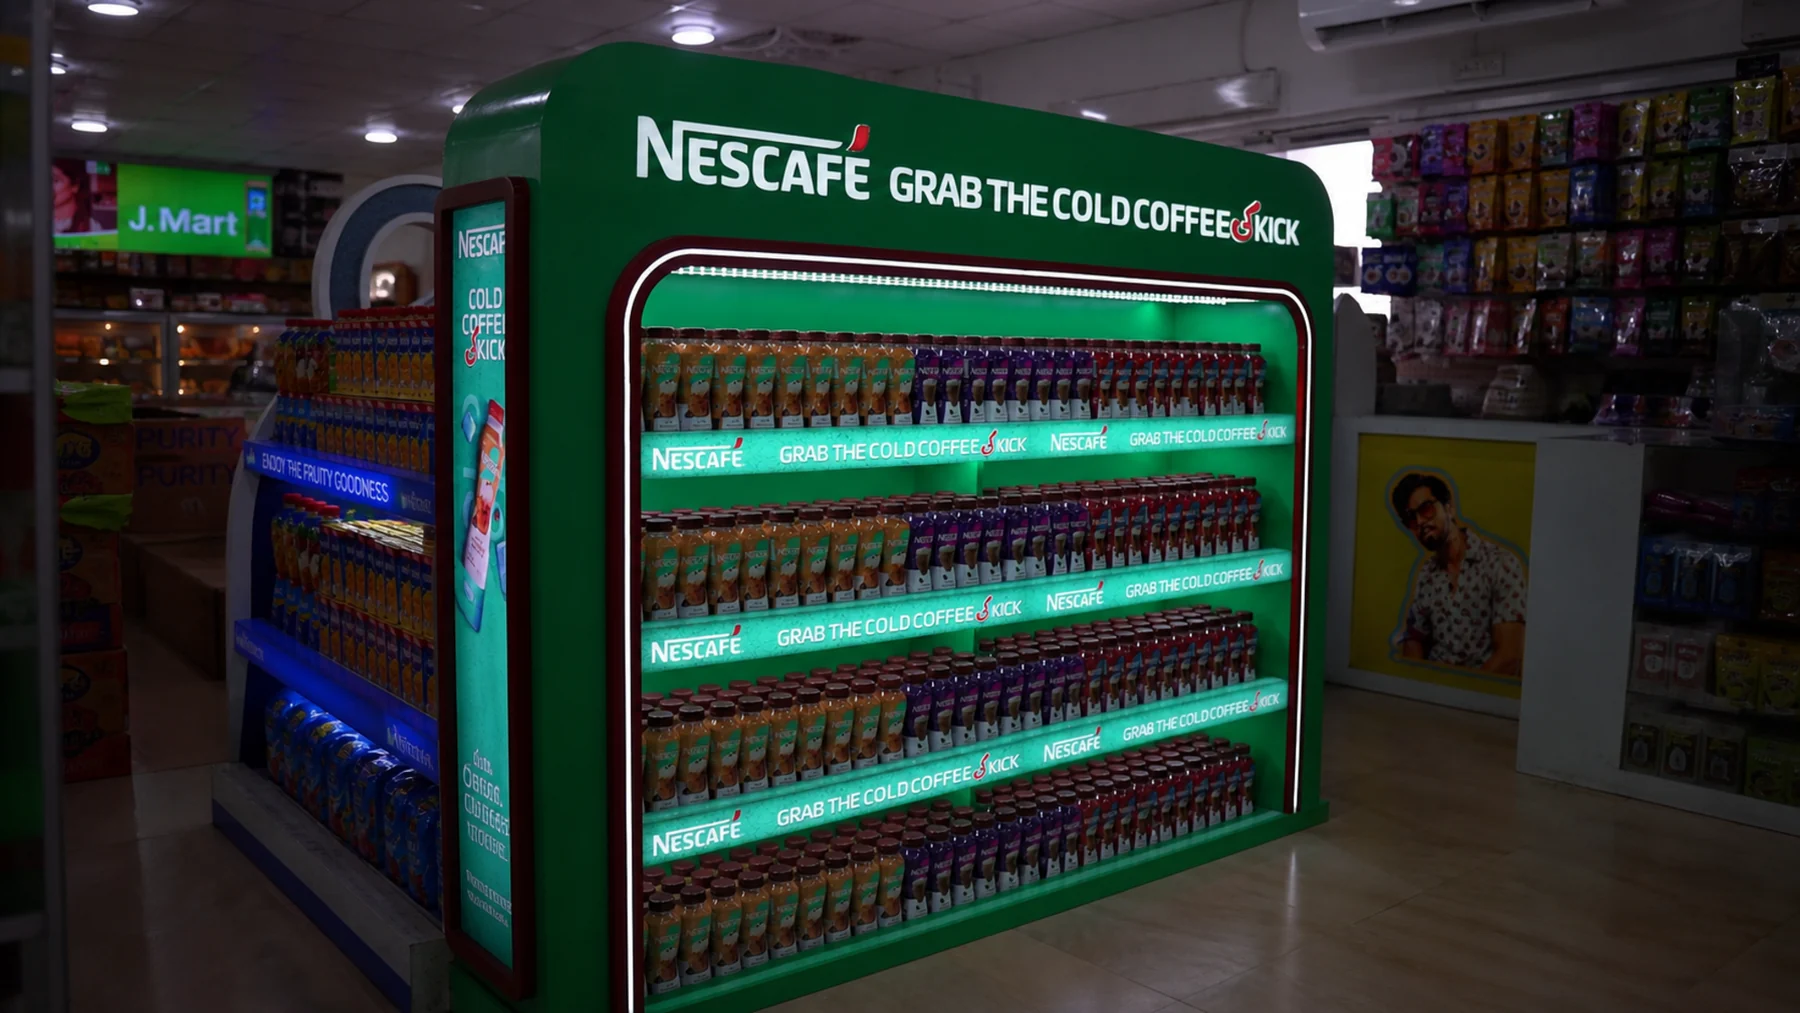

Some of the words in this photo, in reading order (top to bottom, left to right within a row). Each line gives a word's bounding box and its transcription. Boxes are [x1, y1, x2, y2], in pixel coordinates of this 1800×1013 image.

[636, 115, 870, 200] NESCAFÉ
[128, 205, 154, 232] J.
[158, 207, 239, 236] Mart
[889, 166, 983, 209] GRAB
[986, 178, 1049, 218] THE
[1052, 187, 1131, 227] COLD
[1132, 198, 1231, 239] COFFEE
[1254, 214, 1300, 246] KICK
[468, 287, 503, 310] COLD
[477, 338, 506, 361] KICK
[137, 426, 240, 449] PURITY
[779, 444, 828, 464] GRAB
[832, 442, 867, 461] THE
[869, 440, 915, 459] COLD
[918, 438, 980, 457] COFFEE
[997, 437, 1027, 453] KICK
[1129, 430, 1161, 446] GRAB
[1164, 429, 1184, 444] THE
[1186, 428, 1216, 443] COLD
[1217, 427, 1256, 442] COFFEE
[262, 453, 287, 474] ENJOY
[287, 459, 302, 479] THE
[303, 463, 333, 488] FRUITY
[334, 471, 389, 503] GOODNESS
[1126, 583, 1157, 598] GRAB
[1159, 578, 1180, 594] THE
[1182, 574, 1211, 590] COLD
[1213, 567, 1252, 585] COFFEE
[777, 625, 825, 647] GRAB
[829, 620, 862, 640] THE
[865, 615, 910, 635] COLD
[913, 605, 974, 629] COFFEE
[992, 600, 1022, 618] KICK
[1123, 722, 1154, 742] GRAB
[1156, 717, 1177, 733] THE
[1179, 710, 1208, 728] COLD
[1210, 700, 1249, 719] COFFEE
[777, 802, 824, 827] GRAB
[828, 792, 860, 815] THE
[863, 782, 909, 806] COLD
[911, 765, 971, 794] COFFEE
[988, 753, 1020, 774] KICK
